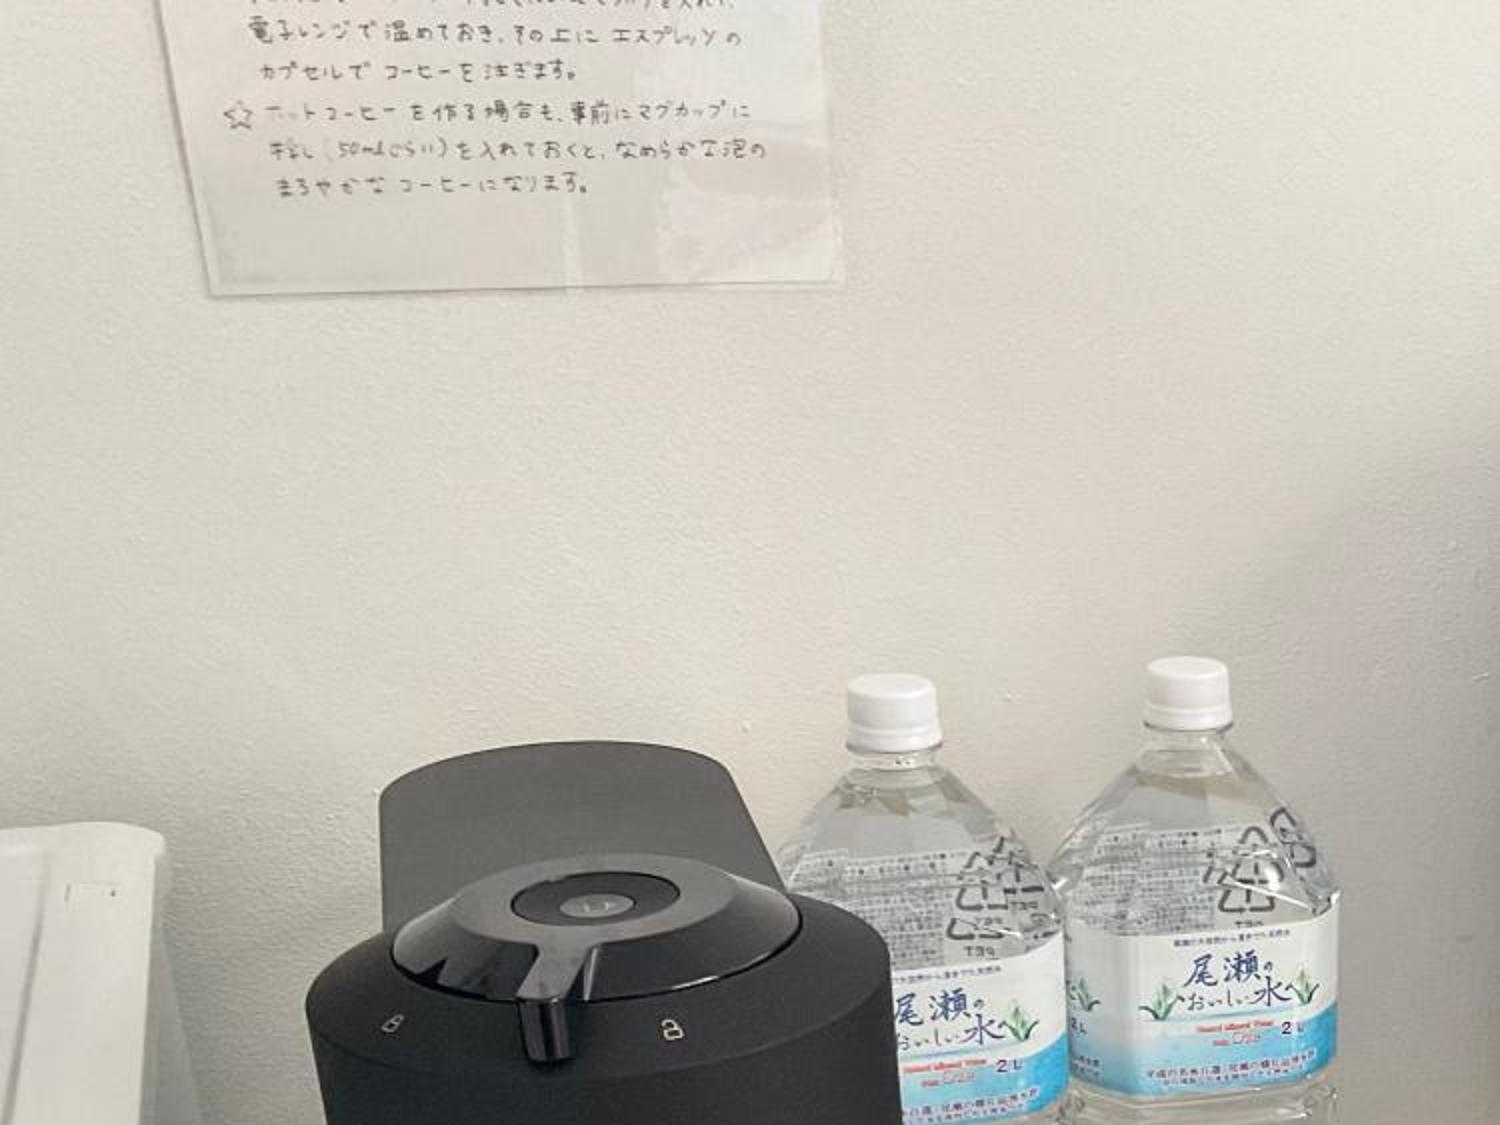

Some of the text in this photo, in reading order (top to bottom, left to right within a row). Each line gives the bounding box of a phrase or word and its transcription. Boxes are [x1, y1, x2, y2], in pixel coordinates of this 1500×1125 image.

[1184, 950, 1274, 988] 尾瀬の
[1187, 976, 1292, 1011] おいしい水
